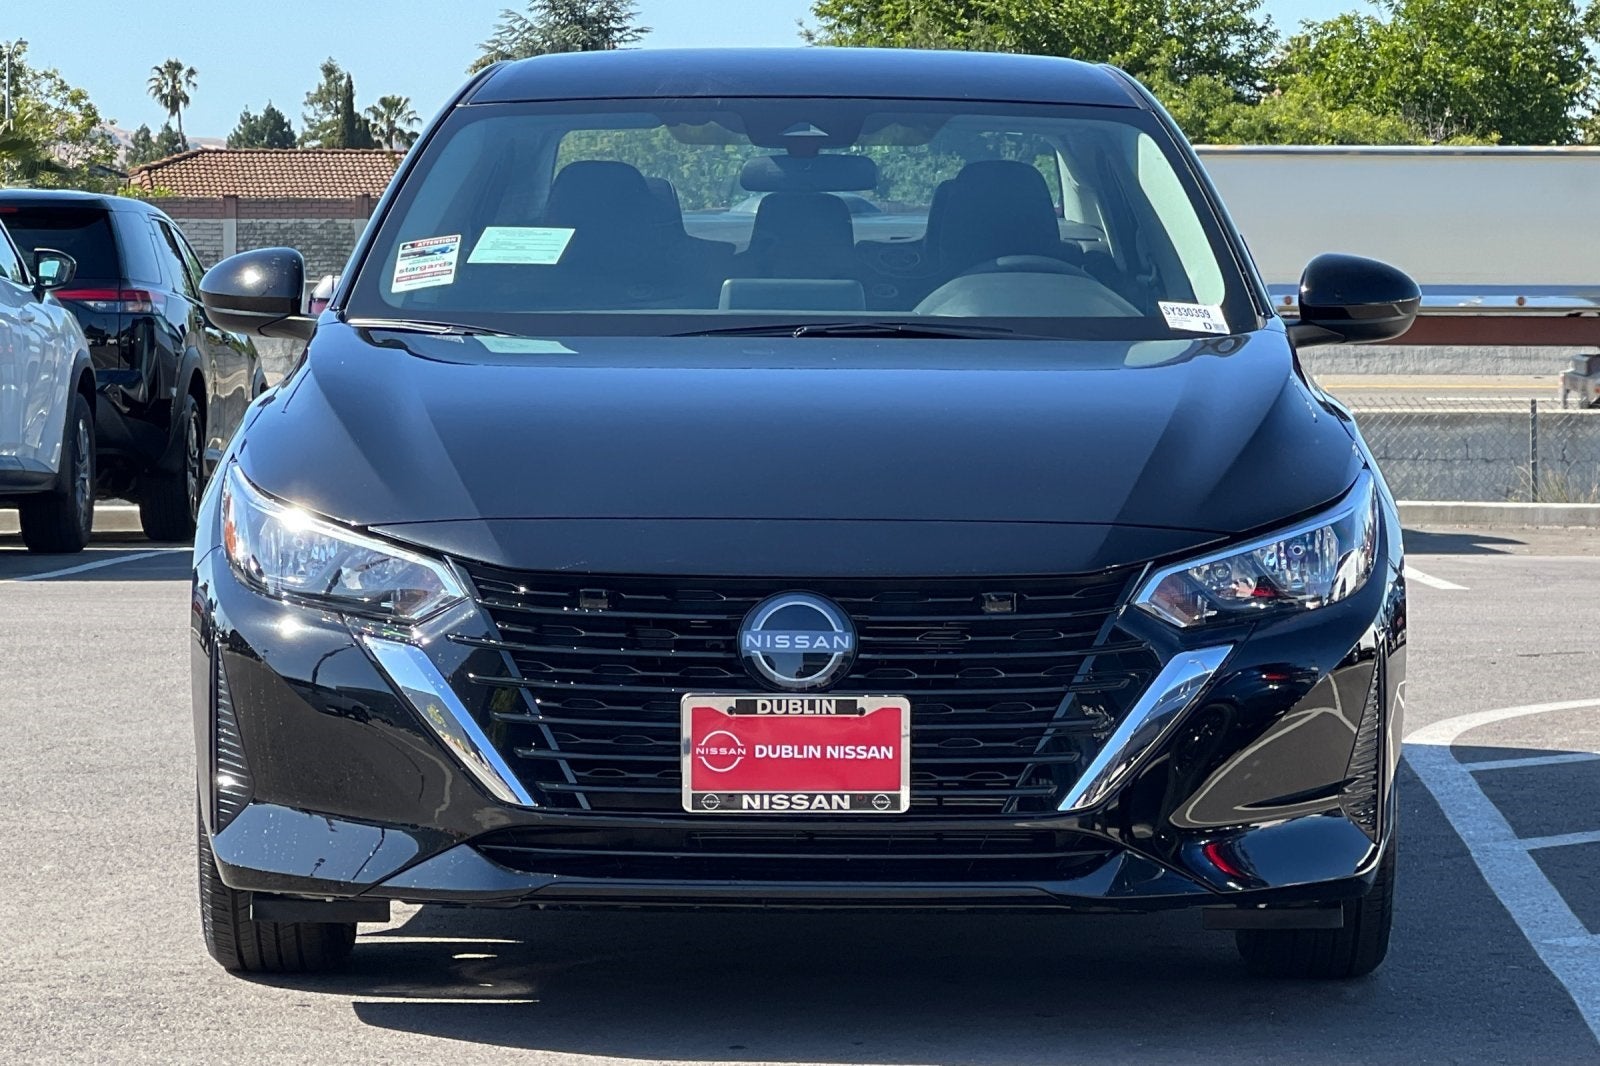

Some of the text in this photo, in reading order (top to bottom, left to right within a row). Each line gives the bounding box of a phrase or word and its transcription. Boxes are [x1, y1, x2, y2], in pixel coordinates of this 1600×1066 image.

[417, 237, 457, 247] ATTENTION
[1162, 305, 1211, 319] SY330359
[745, 634, 849, 649] NISSAN
[756, 699, 836, 715] DUBLIN
[695, 747, 747, 756] NISSAN
[754, 745, 893, 760] DUBLIN NISSAN
[742, 794, 850, 810] NISSAN
